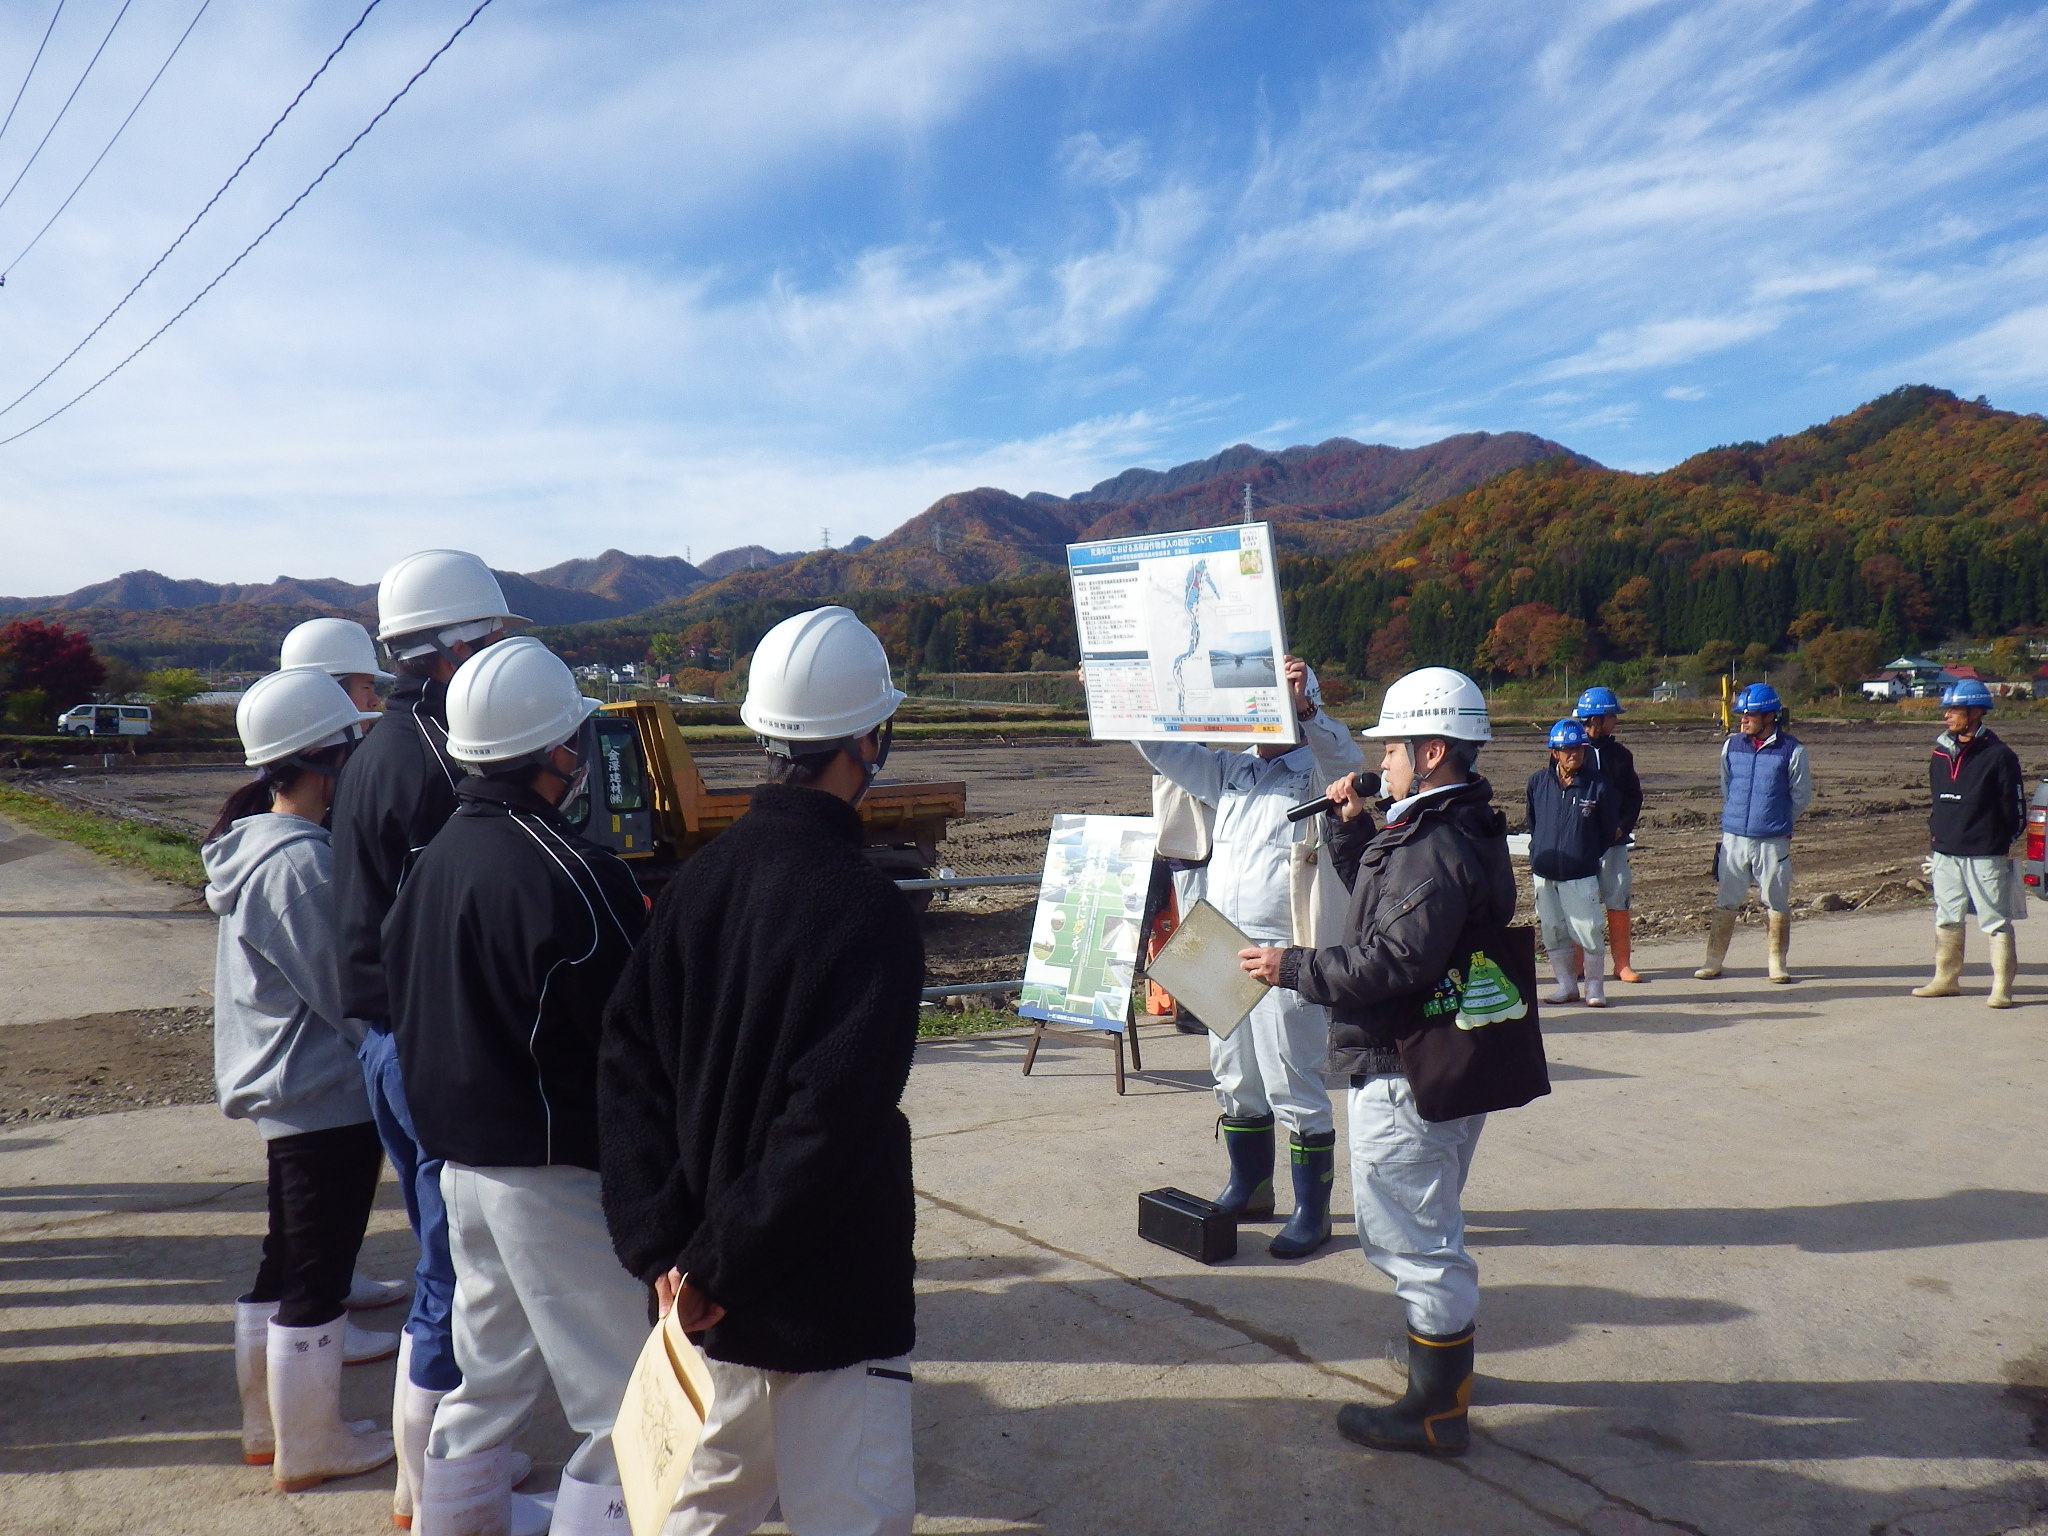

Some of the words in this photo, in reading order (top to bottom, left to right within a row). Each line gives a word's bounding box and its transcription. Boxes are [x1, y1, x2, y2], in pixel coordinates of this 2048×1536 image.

[1395, 706, 1456, 719] 南会津農林事務所
